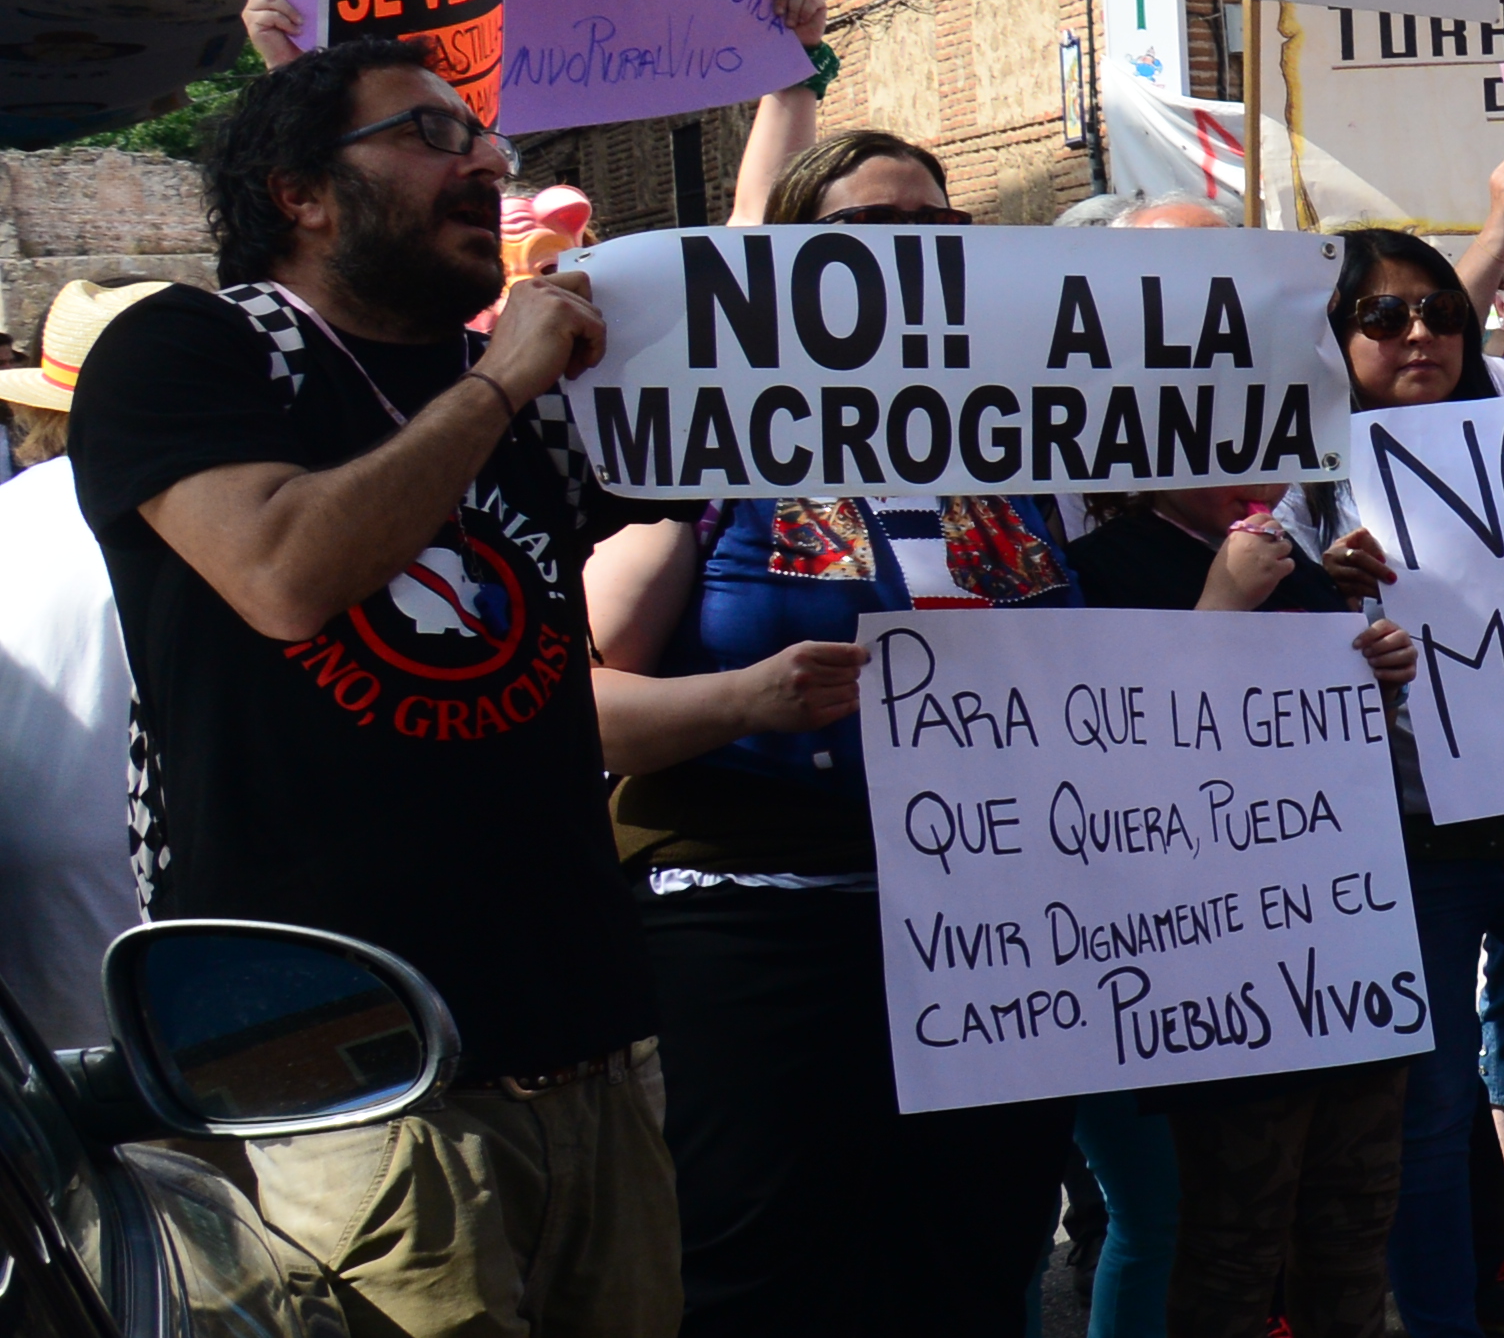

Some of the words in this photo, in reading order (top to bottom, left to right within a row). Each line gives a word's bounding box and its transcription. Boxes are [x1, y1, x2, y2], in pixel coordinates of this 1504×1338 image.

[681, 232, 971, 371] NO!!
[1047, 275, 1112, 369] A
[1142, 276, 1253, 369] LA
[594, 383, 1320, 487] MACROGRANJA
[284, 634, 383, 726] ¡NO,
[394, 623, 572, 741] GRACIAS!
[876, 628, 1039, 749] PARA
[1065, 683, 1148, 753] QUE
[1171, 690, 1223, 751] LA
[1243, 683, 1383, 748] GENTE
[905, 790, 1022, 875] QUE
[1199, 779, 1342, 851] PUEDA
[904, 912, 1031, 973] VIVIR
[1045, 893, 1244, 966] DIGNAMENTE
[1260, 884, 1312, 930] EN
[1331, 871, 1396, 916] EL
[916, 989, 1087, 1048] CAMPO.
[1097, 966, 1272, 1065] PUEBLOS
[1278, 947, 1428, 1039] VIVOS
